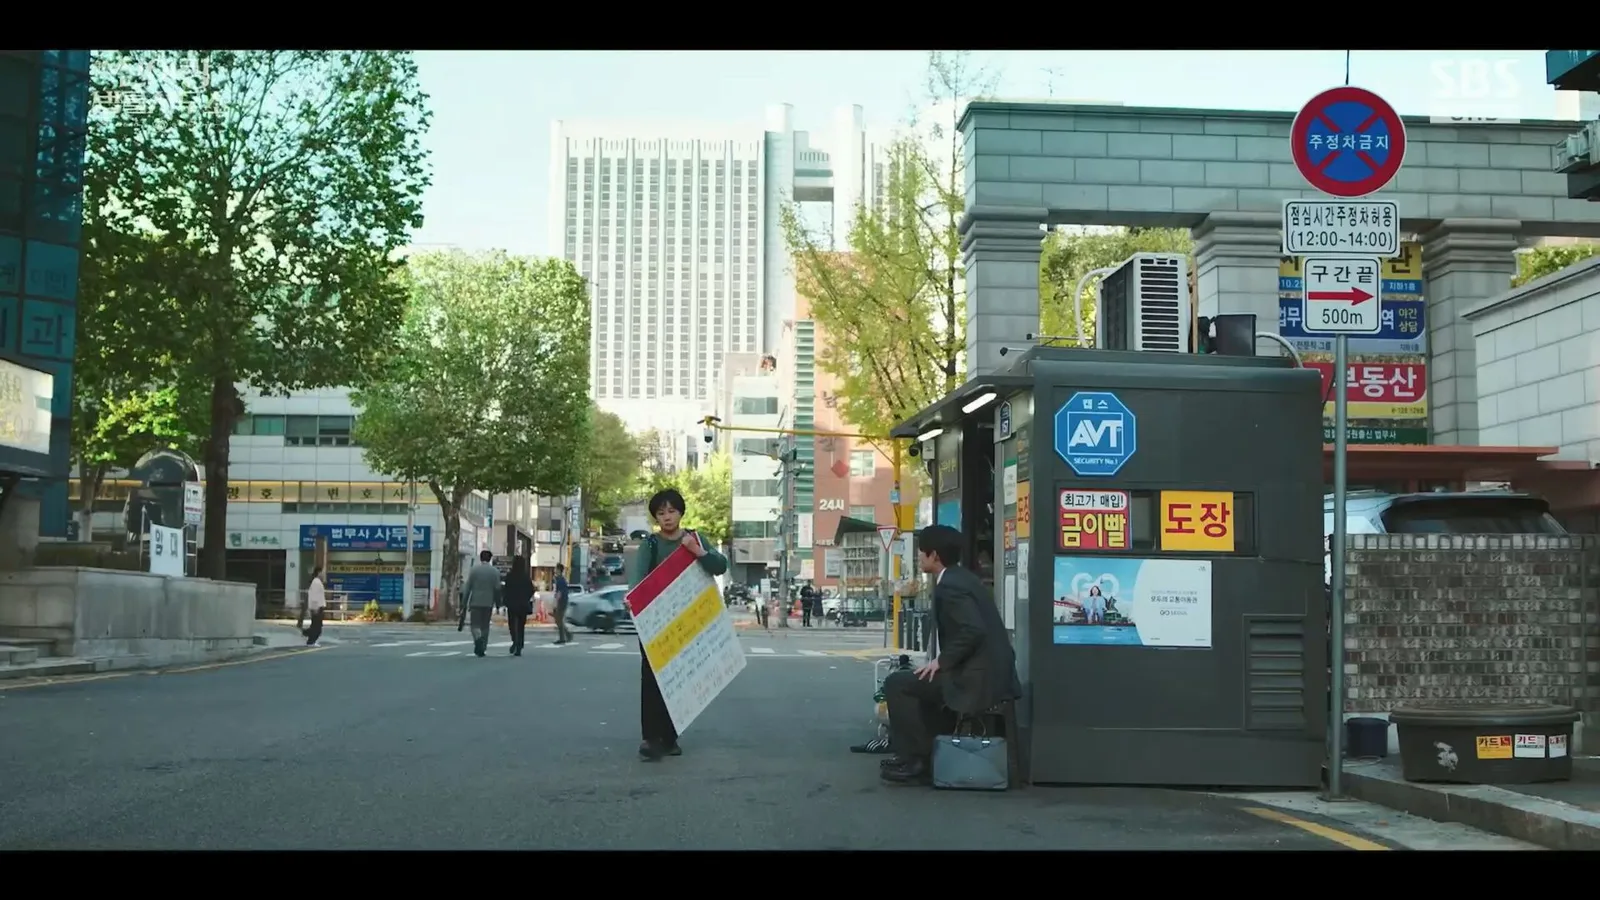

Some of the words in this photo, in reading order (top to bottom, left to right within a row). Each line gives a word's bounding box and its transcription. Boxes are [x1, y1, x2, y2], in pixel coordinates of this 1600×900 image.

[1309, 134, 1389, 149] 주정차금지
[1291, 206, 1392, 227] 점심시간주정차허용
[1291, 231, 1393, 250] (12:00~14:00)
[1322, 308, 1363, 326] 500m
[1398, 308, 1417, 319] 야간
[1398, 321, 1417, 333] 상담
[1073, 457, 1103, 465] SECURITY
[1064, 494, 1095, 507] 최고가
[1100, 494, 1124, 508] 매입!
[1165, 502, 1230, 538] 도장
[331, 528, 369, 540] 법무사
[1061, 512, 1126, 547] 금이빨
[1515, 735, 1537, 744] 카드
